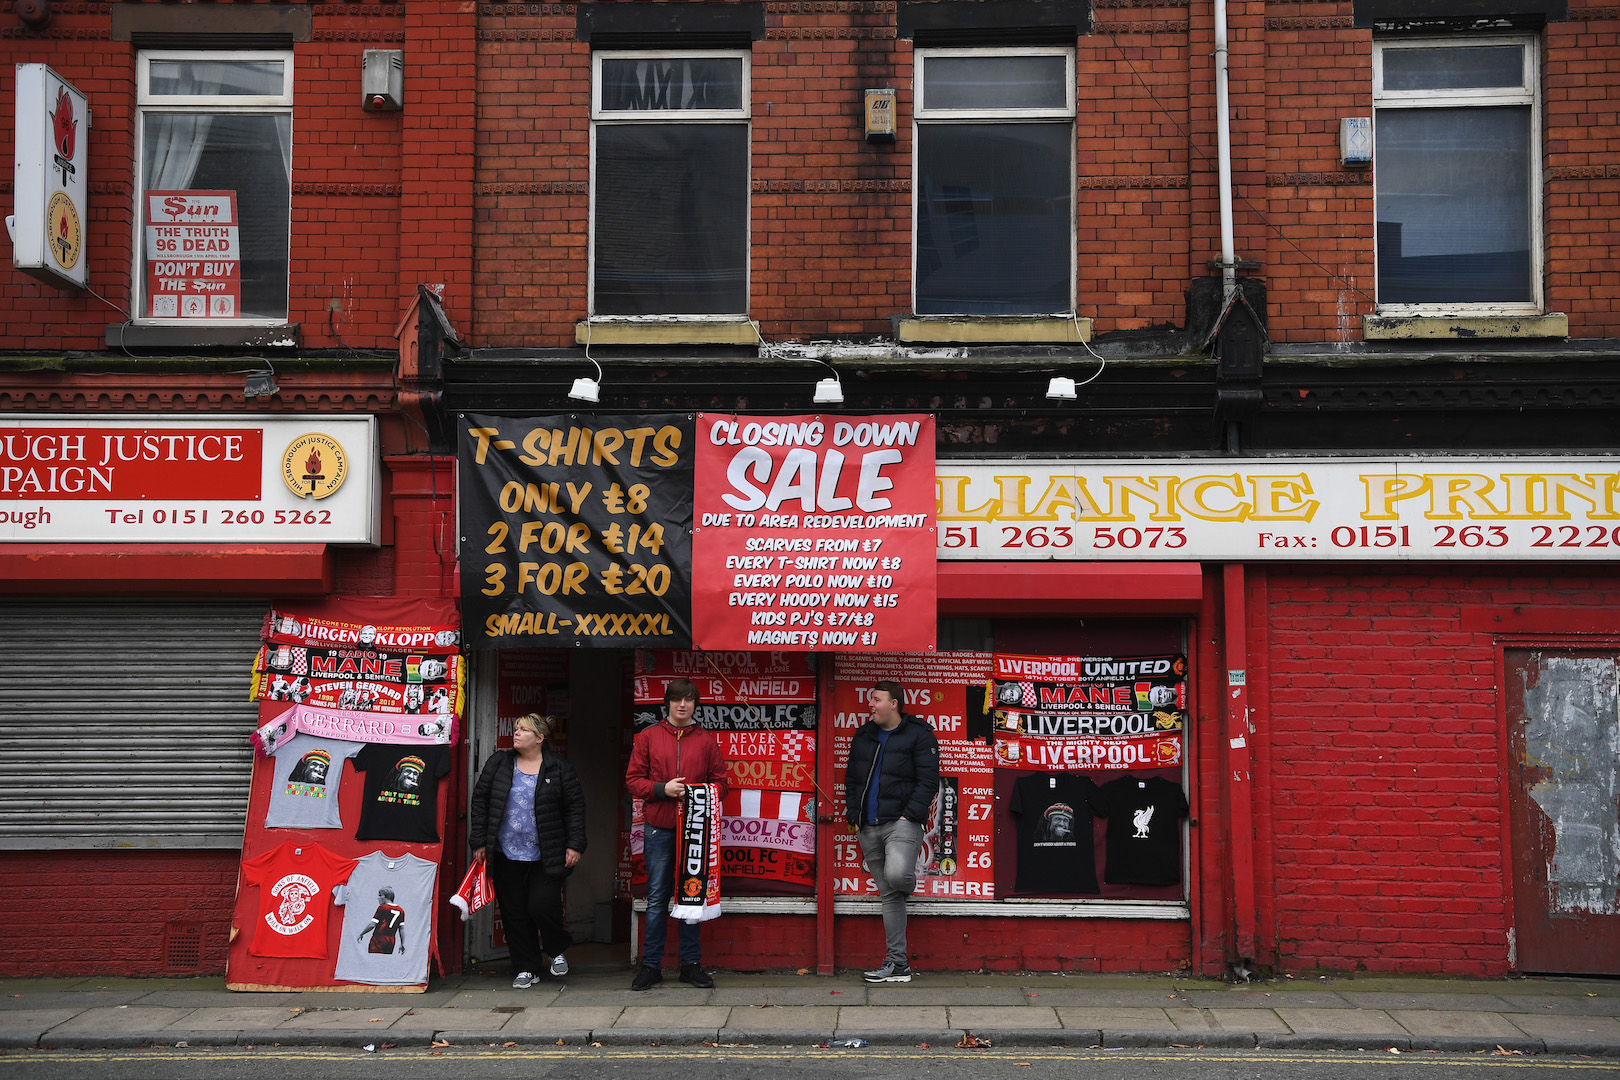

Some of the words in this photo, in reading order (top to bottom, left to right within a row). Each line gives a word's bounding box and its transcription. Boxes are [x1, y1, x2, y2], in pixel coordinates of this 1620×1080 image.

[62, 117, 70, 131] 96
[162, 197, 219, 220] Sun
[155, 228, 181, 237] THE
[185, 228, 229, 238] TRUTH
[156, 239, 177, 252] 96
[183, 239, 230, 252] DEAD
[154, 262, 200, 276] DON'T
[204, 262, 235, 276] BUY
[158, 278, 186, 291] THE
[192, 280, 226, 293] Sun
[710, 420, 824, 446] CLOSING
[834, 422, 920, 447] DOWN
[0, 434, 87, 462] UGH
[99, 434, 244, 466] JUSTICE
[468, 425, 682, 467] T-SHIRTS
[286, 440, 306, 491] HILLSBOROUGH
[308, 437, 336, 450] JUSTICE
[326, 450, 344, 490] CAMPAIGN
[721, 446, 903, 512] SALE
[500, 481, 592, 514] ONLY
[602, 482, 650, 514] £8
[936, 473, 1321, 523] LIANCE
[1358, 472, 1620, 522] PRIN
[105, 509, 144, 524] Tel
[152, 509, 208, 524] 0151
[220, 509, 265, 524] 260
[273, 509, 332, 524] 5262
[702, 513, 732, 527] DUE
[736, 514, 756, 528] TO
[760, 514, 798, 528] AREA
[803, 514, 928, 529] REDEVELOPMENT
[485, 521, 509, 554] 2
[518, 521, 592, 554] FOR
[602, 522, 665, 555] £14
[746, 538, 812, 552] SCARVES
[816, 538, 860, 552] FROM
[862, 539, 882, 552] £7
[1000, 526, 1074, 548] 263
[1092, 526, 1188, 548] 5073
[1258, 532, 1318, 548] Fax:
[1331, 526, 1412, 548] 0151
[1433, 526, 1510, 548] 263
[726, 556, 774, 570] EVERY
[778, 556, 839, 570] T-SHIRT
[842, 556, 878, 570] NOW
[882, 557, 902, 570] £8
[481, 562, 507, 596] 3
[518, 562, 590, 596] FOR
[601, 562, 672, 596] £20
[734, 574, 782, 588] EVERY
[786, 575, 824, 588] POLO
[828, 575, 864, 588] NOW
[866, 575, 893, 588] £10
[728, 592, 777, 607] EVERY
[780, 593, 831, 607] HOODY
[834, 594, 870, 607] NOW
[873, 594, 899, 608] £15
[308, 617, 340, 627] WELCOME
[485, 612, 674, 637] SMALL-XXXXXL
[752, 611, 786, 626] KIDS
[790, 610, 824, 626] PJ'S
[828, 612, 874, 626] £7/£8
[298, 622, 360, 642] JÜRGEN
[375, 632, 436, 646] KLOPP
[748, 630, 819, 646] MAGNETS
[822, 631, 858, 646] NOW
[862, 632, 878, 646] £1
[338, 650, 377, 658] SADIO
[672, 652, 756, 666] LIVERPOOL
[771, 651, 790, 666] FC
[707, 666, 732, 674] NEVER
[998, 658, 1079, 676] LIVERPOOL
[1084, 660, 1170, 676] UNITED
[311, 671, 356, 680] LIVERPOOL
[364, 673, 402, 682] SENEGAL
[314, 681, 353, 694] STEVEN
[356, 682, 402, 700] GERRARD
[710, 680, 723, 694] IS
[738, 680, 800, 696] ANFIELD
[310, 699, 326, 707] THANKS
[447, 690, 456, 712] STEVIE
[775, 704, 798, 722] FC
[302, 711, 394, 736] GERRARD
[401, 724, 412, 734] 8
[763, 720, 794, 729] ALONE
[1026, 714, 1154, 735] LIVERPOOL
[308, 728, 350, 739] LIVERPOOL
[730, 732, 776, 744] NEVER
[728, 744, 776, 756] ALONE
[1026, 744, 1151, 764] LIVERPOOL
[781, 764, 806, 780] FC
[738, 777, 764, 786] WALK
[768, 780, 800, 788] ALONE
[962, 787, 994, 796] SCARVE
[968, 804, 992, 820] £7
[686, 788, 706, 876] UNITED
[776, 822, 800, 840] FC
[762, 836, 794, 846] ALONE
[760, 850, 778, 864] FC
[966, 851, 992, 868] £6
[272, 880, 286, 894] SONS
[296, 876, 318, 894] ANFIELD
[932, 880, 994, 896] HERE
[388, 910, 400, 928] 7
